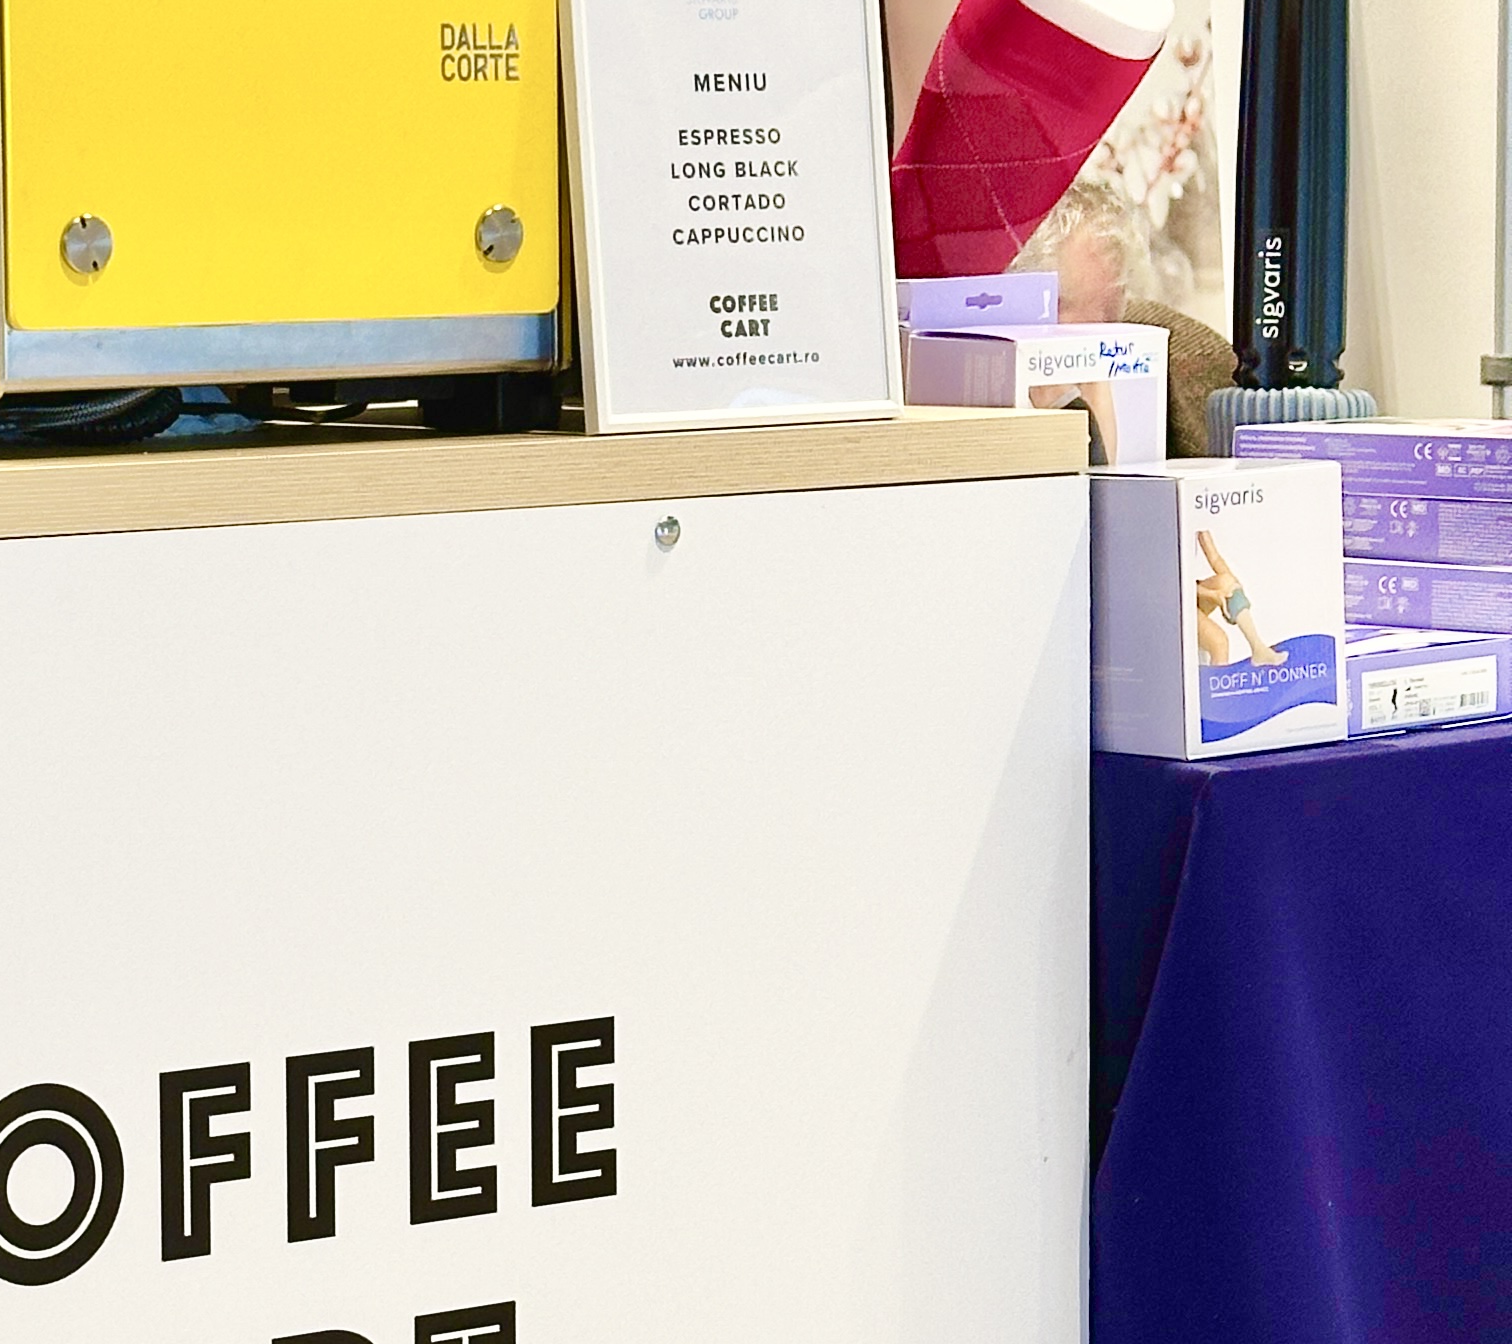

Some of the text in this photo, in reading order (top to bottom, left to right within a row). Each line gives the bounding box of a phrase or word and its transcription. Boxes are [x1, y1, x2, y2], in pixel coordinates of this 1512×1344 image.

[698, 7, 739, 21] GROUP
[440, 22, 519, 51] DALLA
[441, 53, 520, 82] CORTE
[694, 72, 768, 93] MENIU
[678, 128, 782, 147] ESPRESSO
[671, 160, 798, 180] LONG BLACK
[688, 193, 786, 212] CORTADO
[672, 225, 805, 246] CAPPUCCINO
[1255, 236, 1285, 339] sigvaris
[709, 293, 779, 314] COFFEE
[720, 318, 770, 338] CART
[672, 350, 820, 369] www.coffeecart.ro
[1028, 347, 1096, 377] sigvaris
[1195, 483, 1264, 514] sigvaris
[1209, 672, 1248, 692] DOFF
[1268, 663, 1327, 685] DONNER
